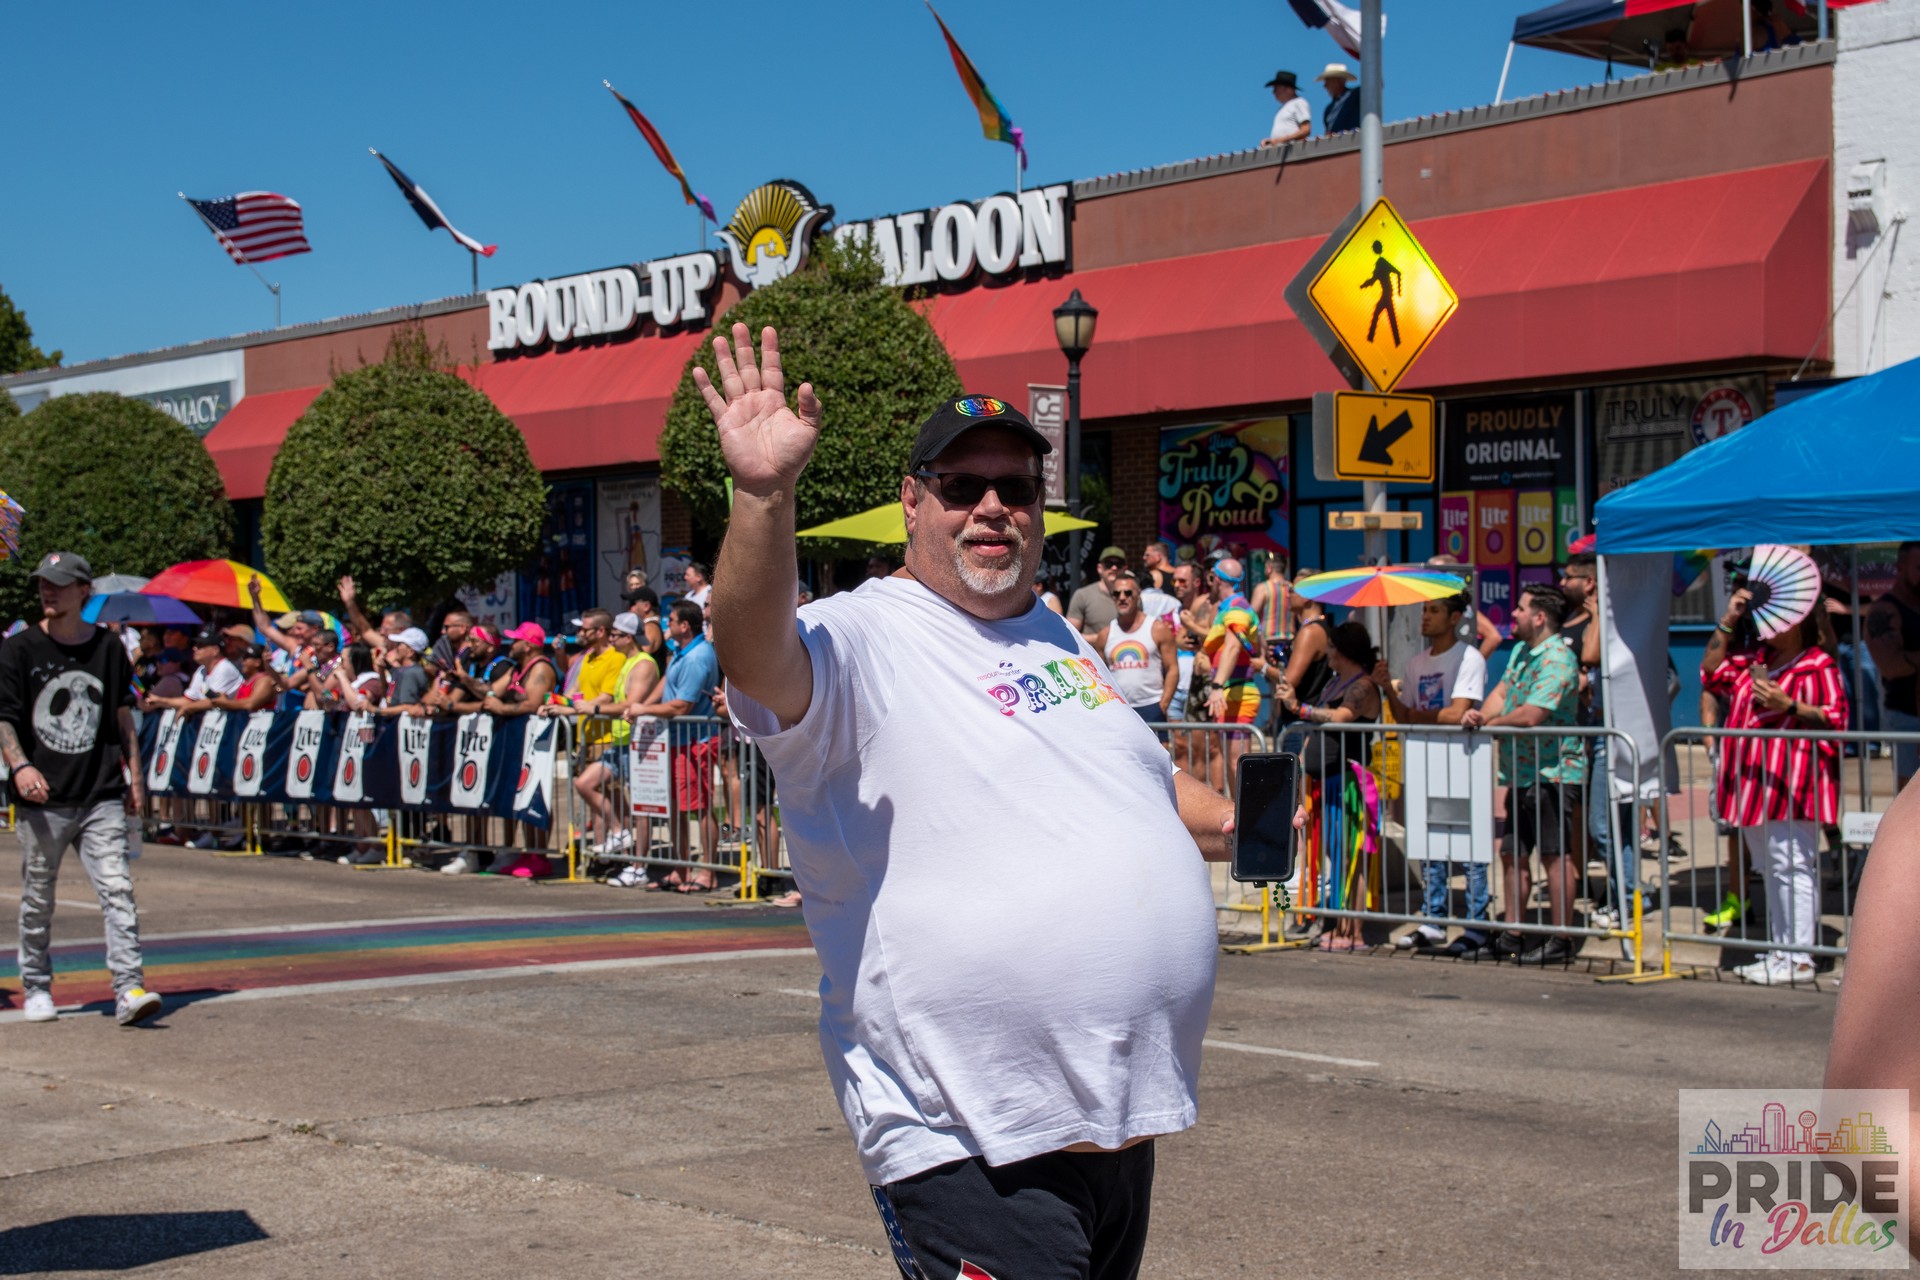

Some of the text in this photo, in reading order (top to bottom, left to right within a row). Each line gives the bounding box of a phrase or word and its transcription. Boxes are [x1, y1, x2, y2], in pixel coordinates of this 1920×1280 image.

[486, 253, 718, 350] ROUND-UP
[1466, 405, 1564, 434] PROUDLY
[1606, 395, 1686, 421] TRULY
[1465, 438, 1562, 464] ORIGINAL
[1158, 446, 1248, 507] Truly
[1178, 481, 1278, 538] Proud
[1442, 509, 1468, 530] Lite
[1480, 506, 1510, 529] Lite
[1520, 504, 1551, 527] Lite
[1481, 581, 1510, 604] Lite
[295, 727, 321, 751] Lite
[403, 728, 429, 755] Lite
[459, 730, 488, 757] Lite
